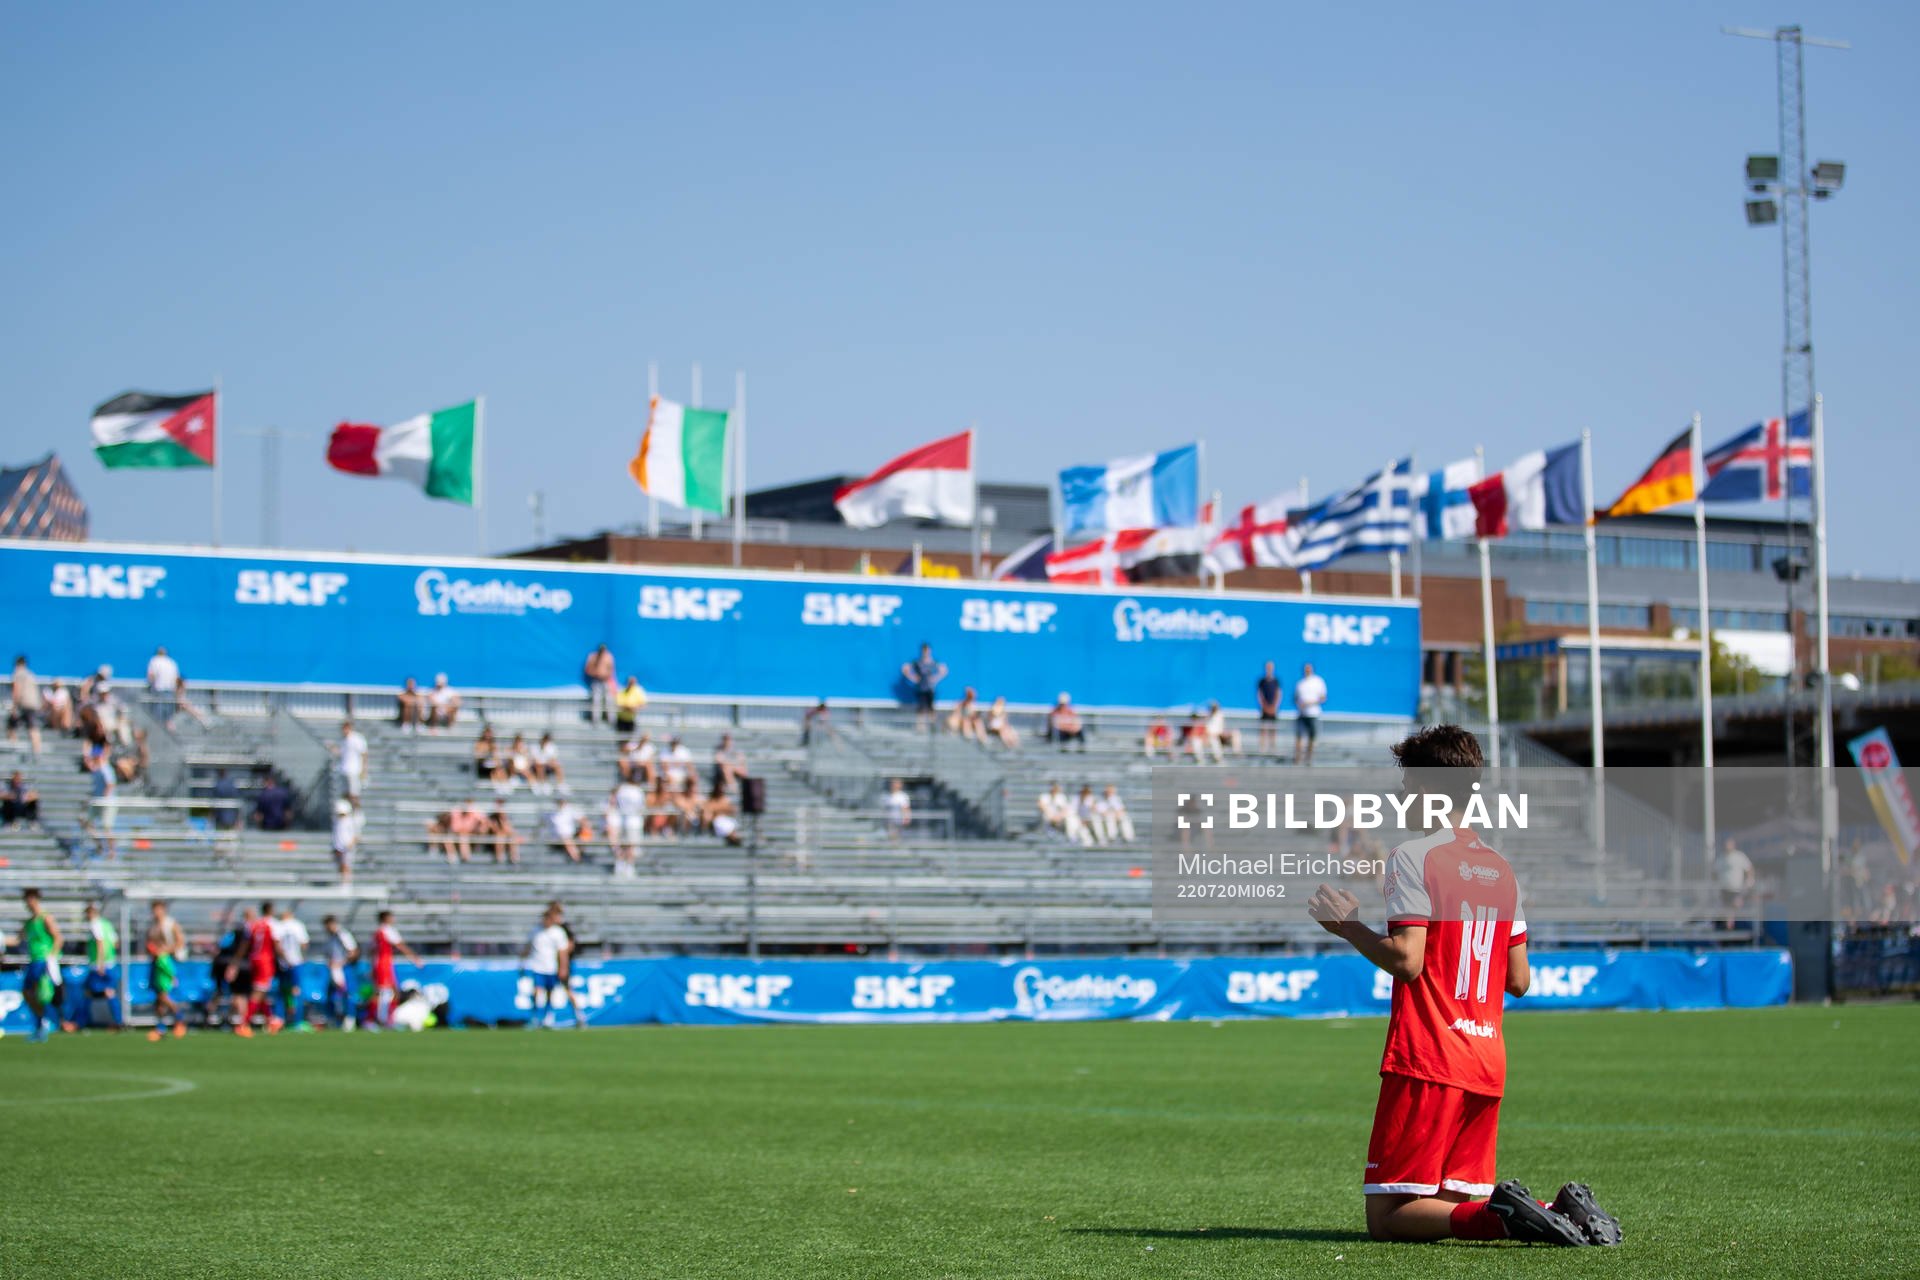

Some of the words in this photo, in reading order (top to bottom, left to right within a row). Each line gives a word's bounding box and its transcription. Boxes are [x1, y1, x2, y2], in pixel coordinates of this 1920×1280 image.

[51, 564, 164, 599] SKF
[236, 571, 347, 605] SKF
[639, 586, 741, 620] SKF
[802, 593, 901, 626] SKF
[960, 600, 1056, 633] SKF
[1303, 613, 1389, 645] SKF
[1455, 900, 1498, 1003] 14
[686, 974, 792, 1007] SKF
[852, 976, 954, 1008] SKF
[1227, 970, 1318, 1003] SKF
